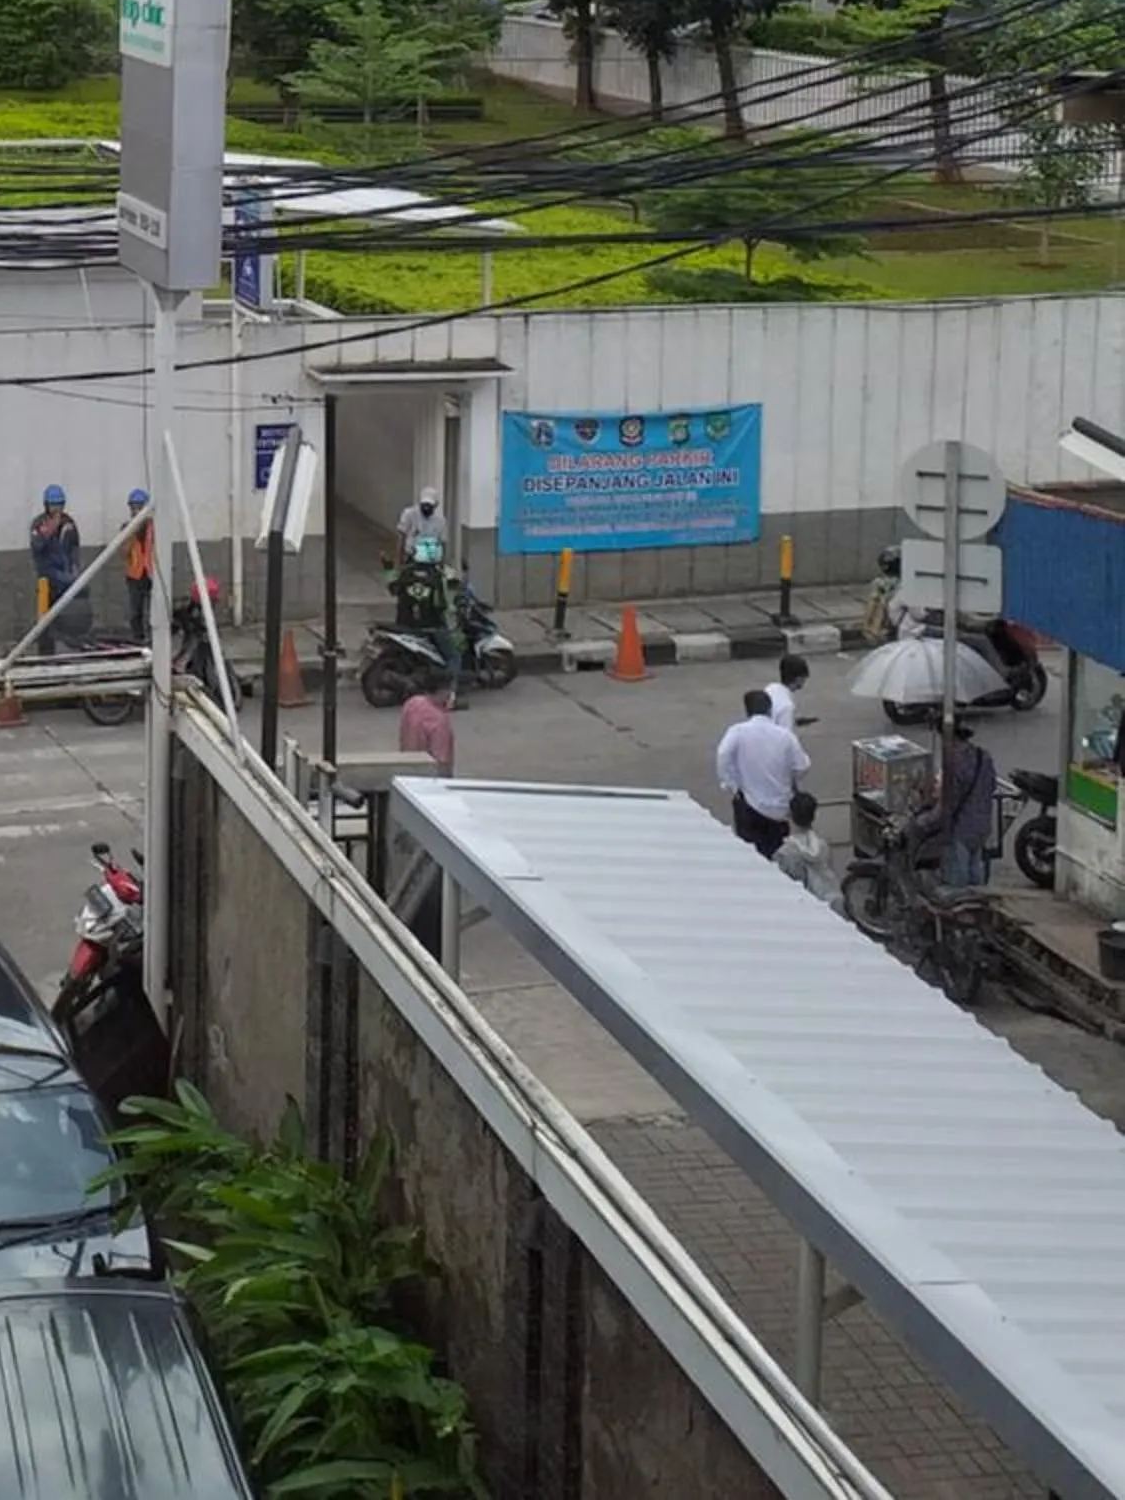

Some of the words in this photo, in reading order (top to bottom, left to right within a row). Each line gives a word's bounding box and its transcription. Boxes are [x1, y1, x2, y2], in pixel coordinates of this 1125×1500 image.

[548, 454, 643, 471] DILARANG
[523, 471, 650, 492] DISEPANJANG
[654, 469, 712, 487] JALAN
[716, 467, 739, 485] INI
